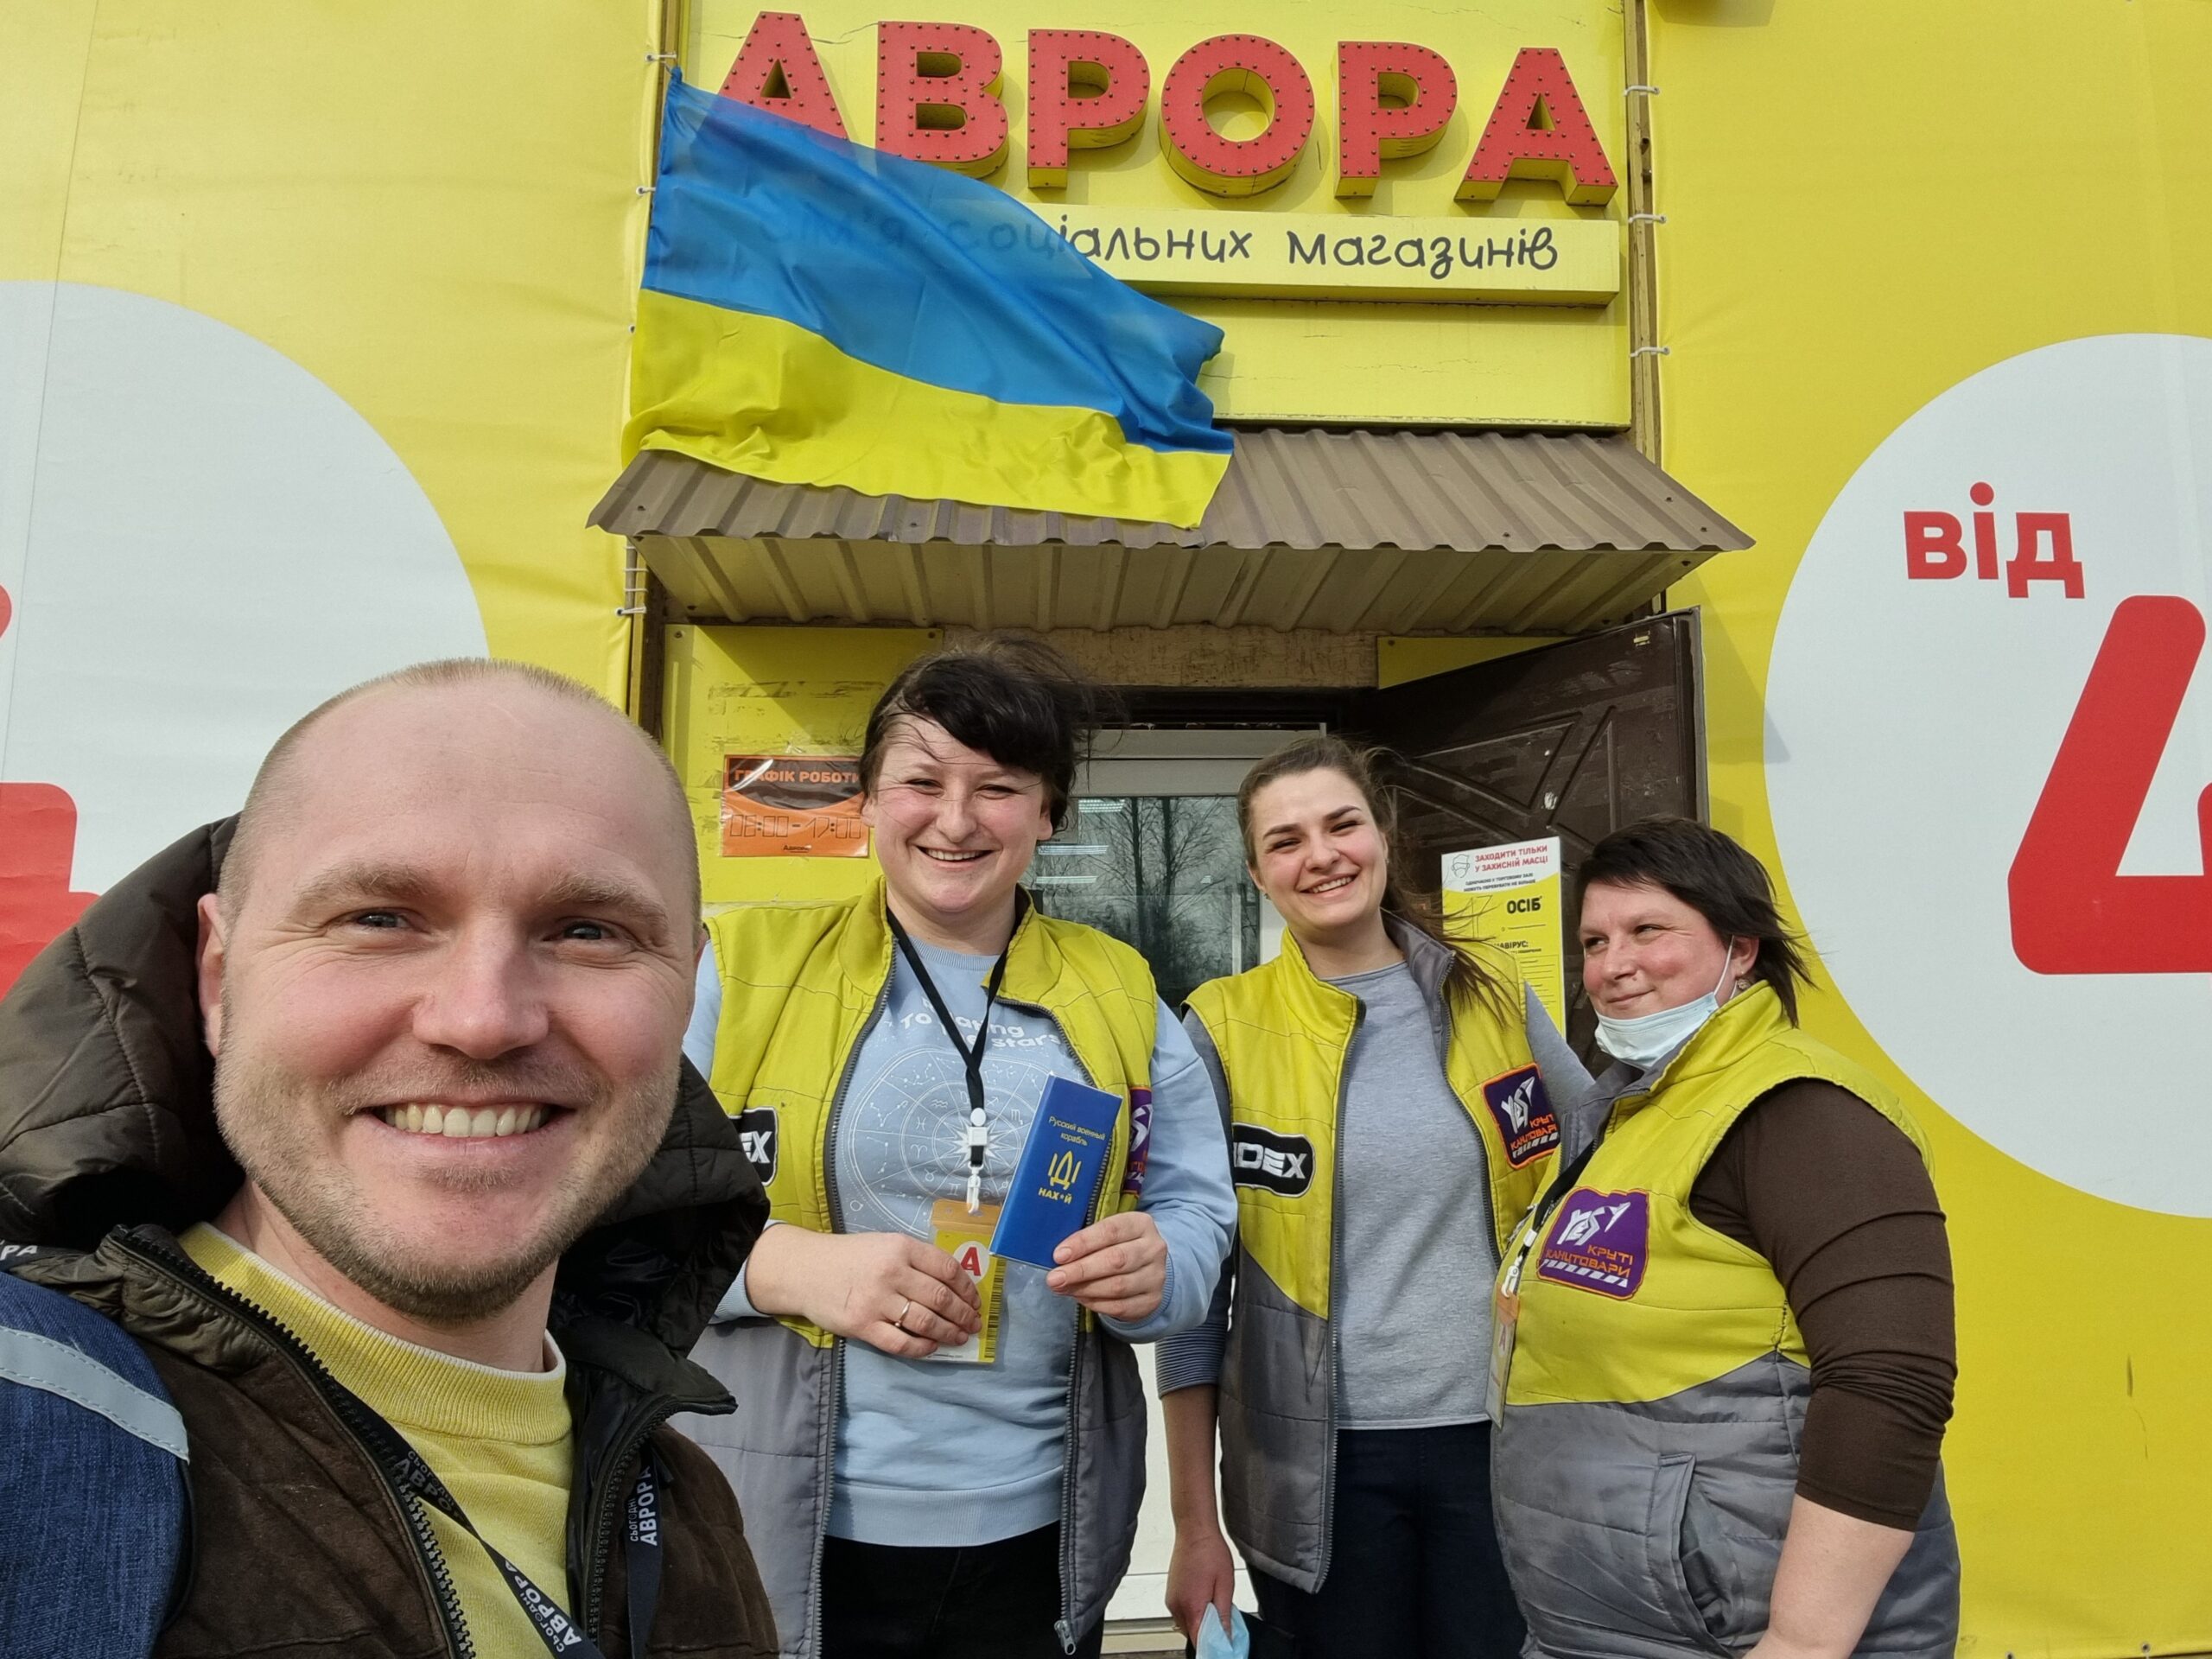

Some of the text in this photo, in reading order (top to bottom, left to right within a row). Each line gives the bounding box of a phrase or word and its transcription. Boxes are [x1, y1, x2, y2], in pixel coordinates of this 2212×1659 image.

[717, 10, 1618, 206] АВРОРА
[1287, 226, 1558, 280] магазинів
[1903, 480, 2085, 599] від
[1474, 844, 1548, 863] ЗАХОДИТИ ТІЛЬКИ
[1481, 857, 1521, 872] ЗАХИСНІЙ
[1522, 855, 1548, 866] МАСЦІ
[1060, 1132, 1088, 1146] корабль
[1545, 1249, 1631, 1277] КАНЦТОВАРИ
[1586, 1244, 1634, 1265] КРУТІ
[637, 1465, 658, 1547] АВРОРА
[504, 1559, 582, 1649] АВРОРА
[518, 1591, 566, 1654] СЬОГОДНІ
